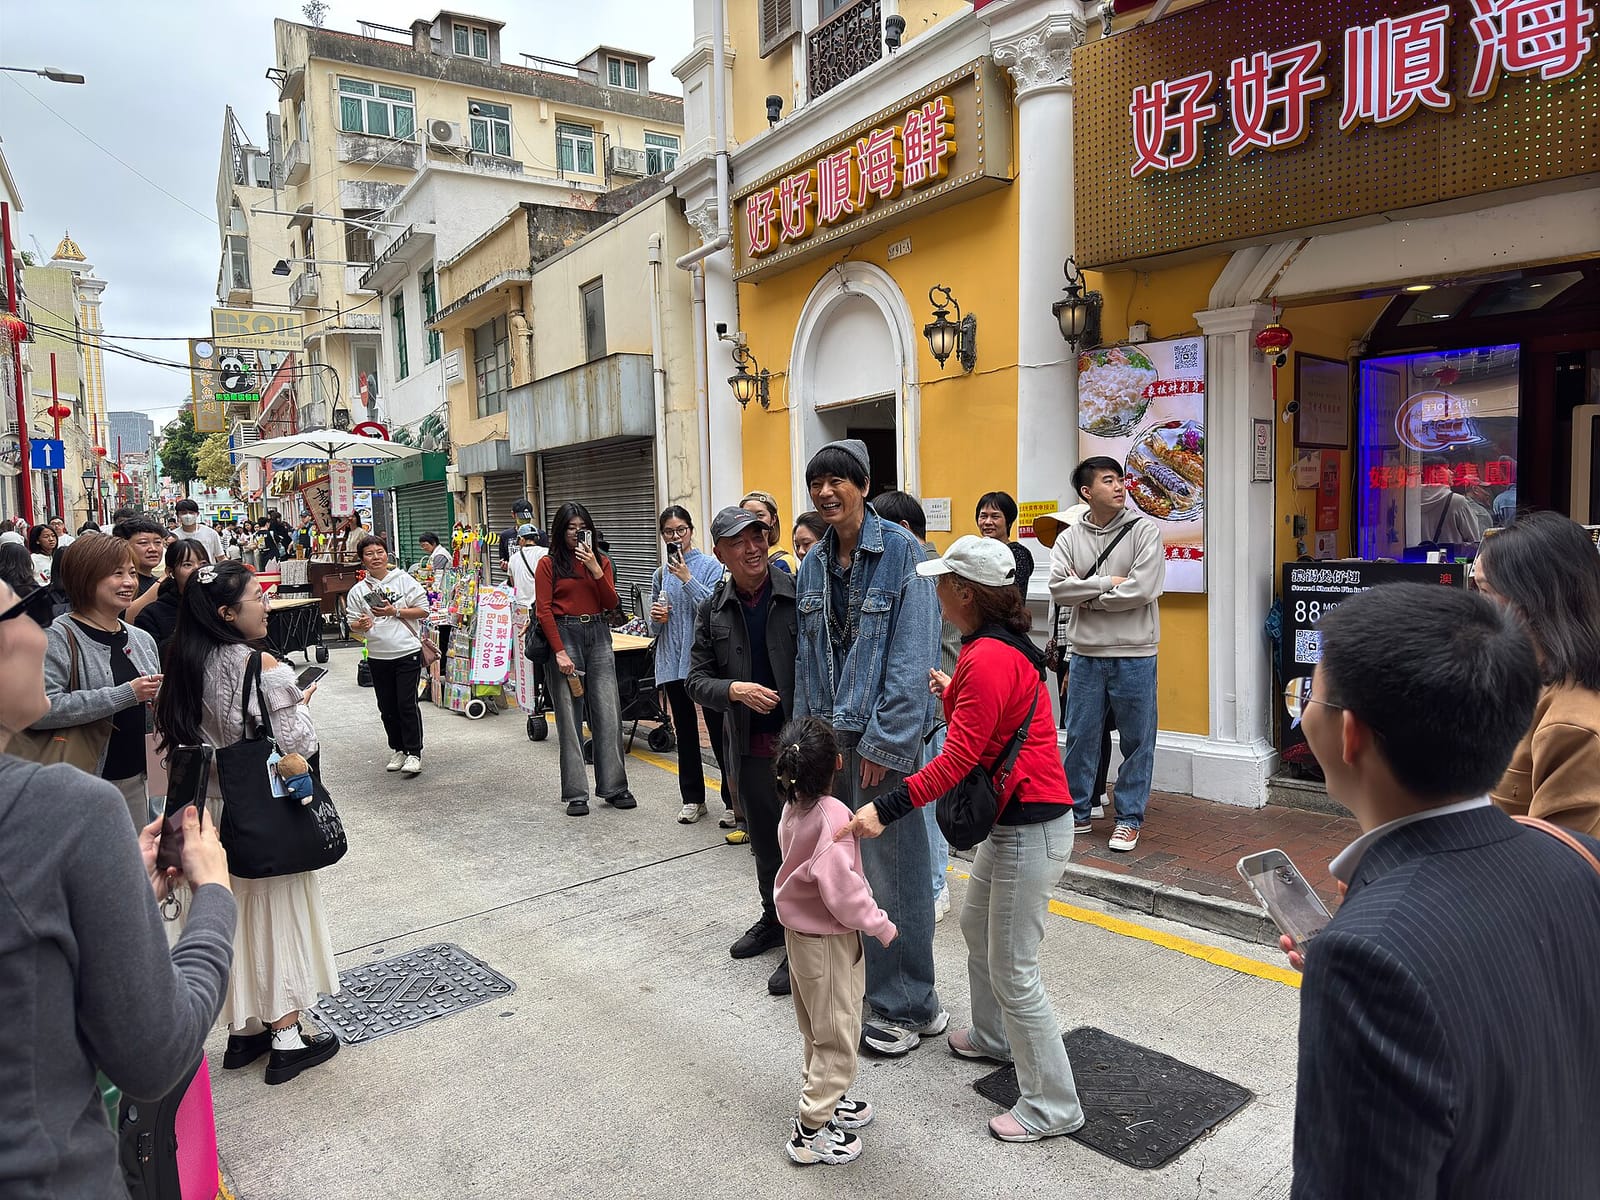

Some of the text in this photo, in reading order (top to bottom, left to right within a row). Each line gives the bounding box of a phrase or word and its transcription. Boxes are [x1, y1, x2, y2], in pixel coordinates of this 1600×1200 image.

[1130, 0, 1593, 177] 好好順海
[746, 97, 949, 257] 好好順海鮮
[1294, 600, 1321, 623] 88
[483, 613, 497, 640] Berry
[481, 642, 494, 669] Store
